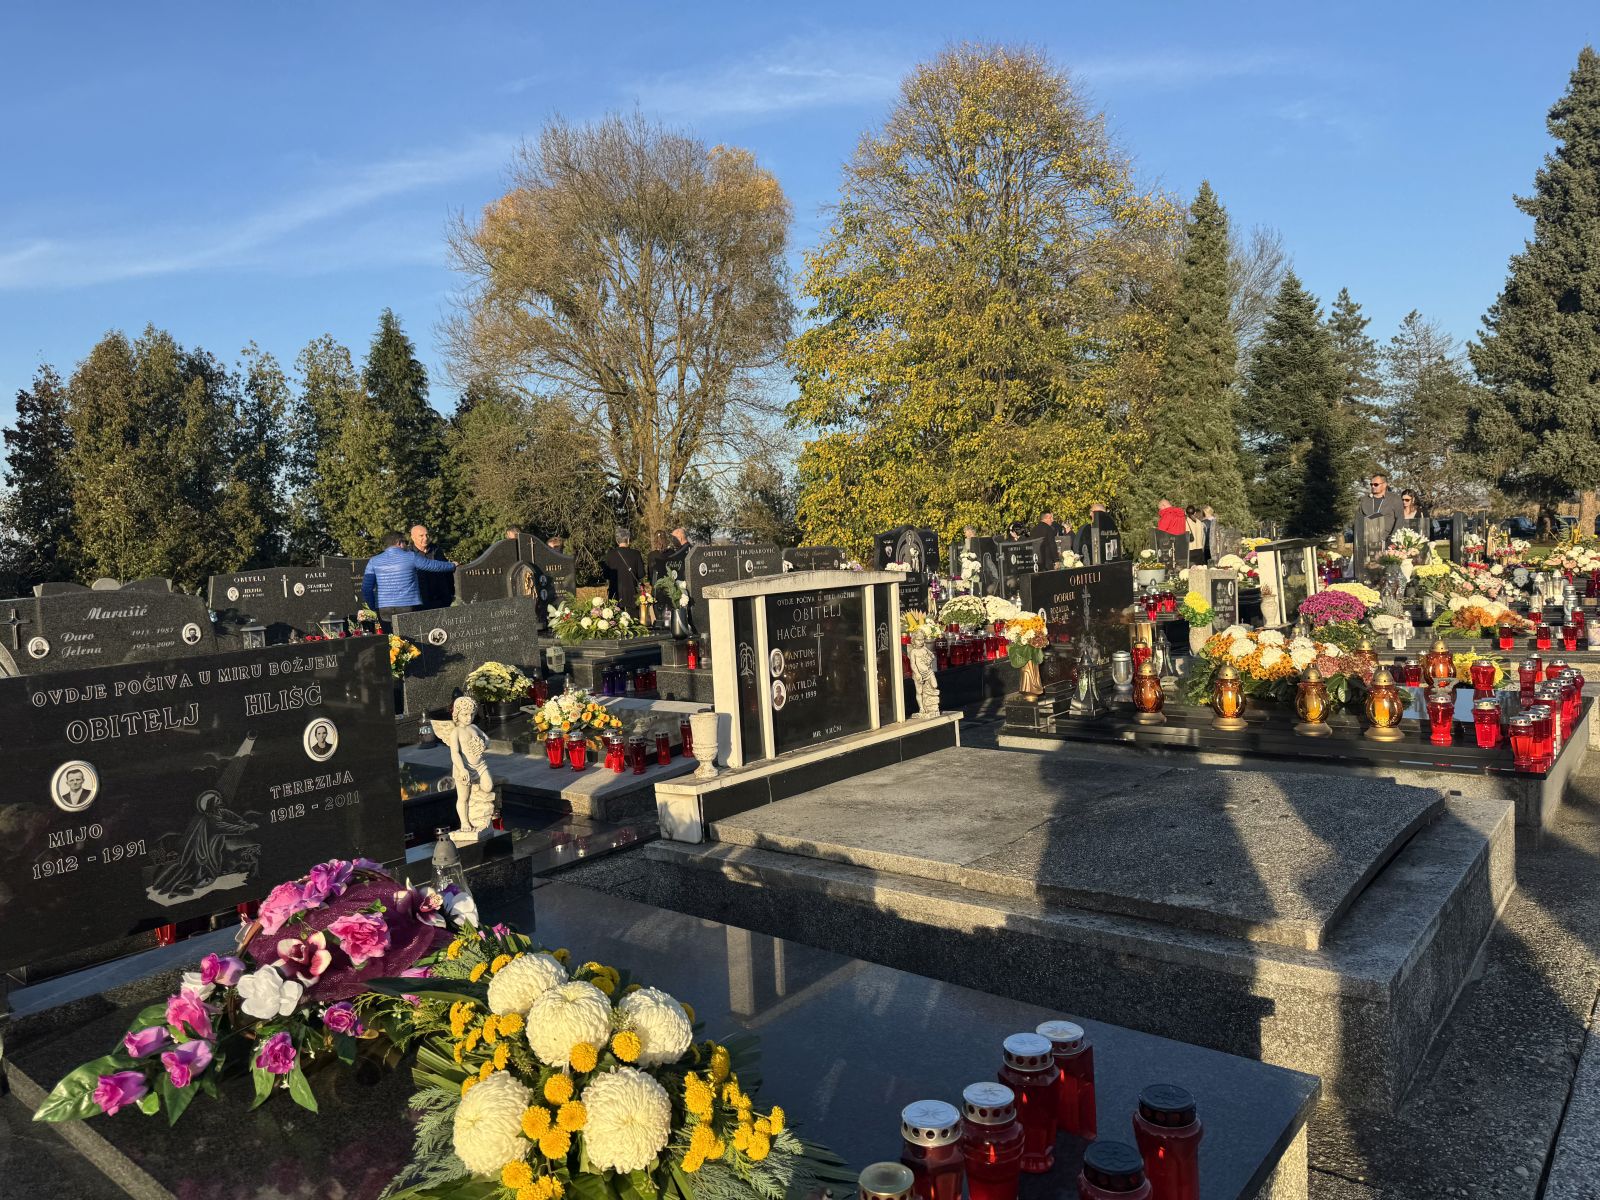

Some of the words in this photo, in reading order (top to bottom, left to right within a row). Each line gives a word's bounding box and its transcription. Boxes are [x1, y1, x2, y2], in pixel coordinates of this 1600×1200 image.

[1069, 571, 1101, 587] OBITELJ
[83, 604, 148, 621] Marušić
[441, 615, 473, 628] OBITELJ
[792, 603, 841, 622] OBITELJ
[776, 625, 807, 641] HAČEK
[61, 645, 102, 659] Jelena
[788, 648, 814, 660] ANTUN
[32, 684, 108, 707] OVDJE
[115, 672, 194, 697] POČIVA
[199, 670, 211, 685] U
[218, 664, 263, 683] MIRU
[269, 654, 339, 677] BOŽJEM
[785, 679, 817, 693] MATILDA
[66, 702, 199, 744] OBITELJ
[244, 681, 322, 717] HLIŠĆ
[269, 770, 354, 800] TEREZIJA
[270, 803, 306, 824] 1912
[324, 790, 360, 811] 2011
[48, 823, 103, 849] MIJO
[32, 855, 79, 880] 1912
[102, 839, 147, 864] 1991
